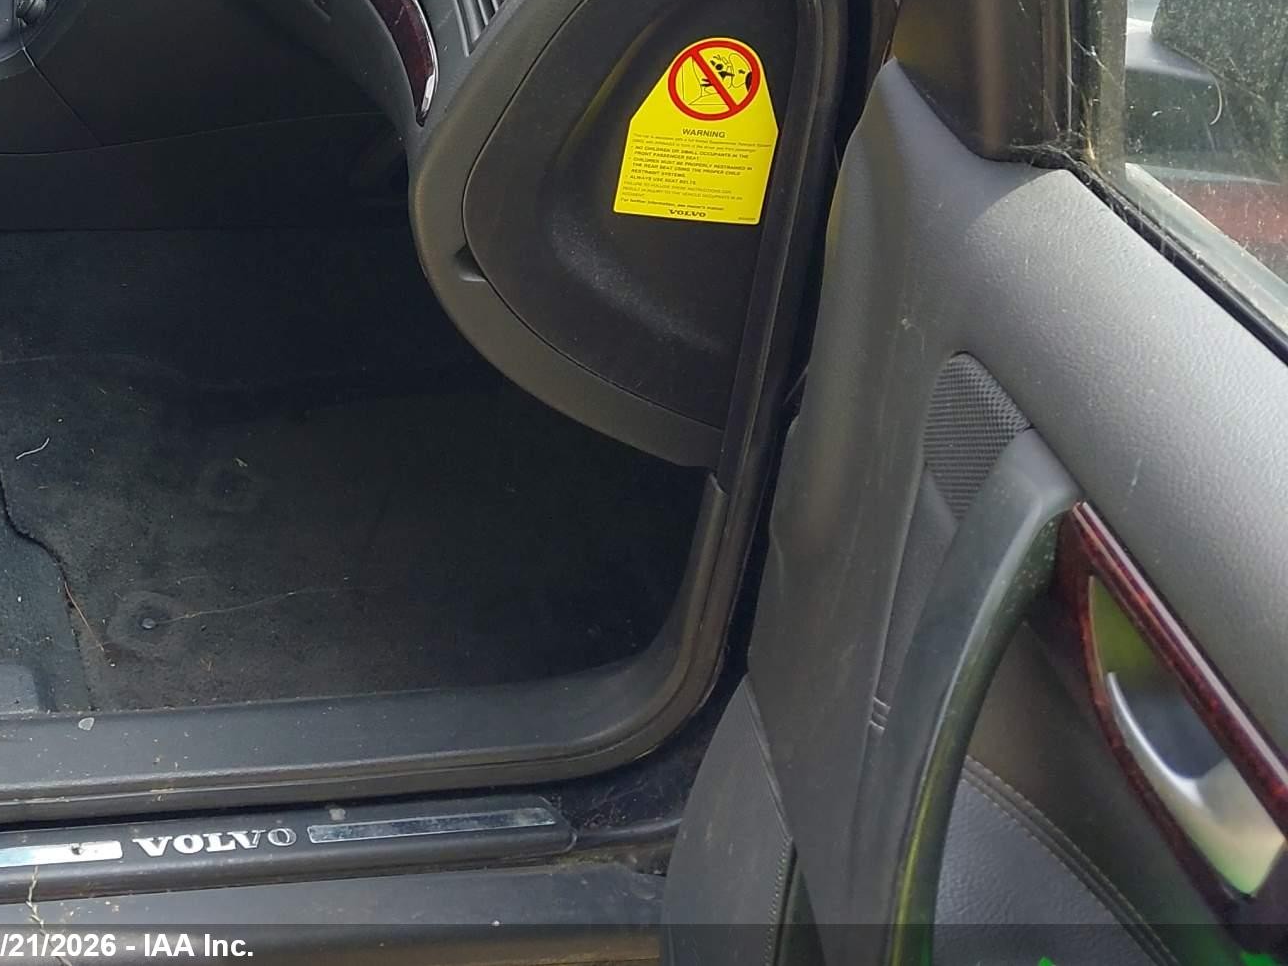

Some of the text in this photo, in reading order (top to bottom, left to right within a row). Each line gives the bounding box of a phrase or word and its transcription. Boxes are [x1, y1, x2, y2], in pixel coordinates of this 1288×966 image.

[682, 128, 726, 139] WARNING
[668, 209, 706, 218] VOLVO
[133, 828, 297, 858] VOLVO
